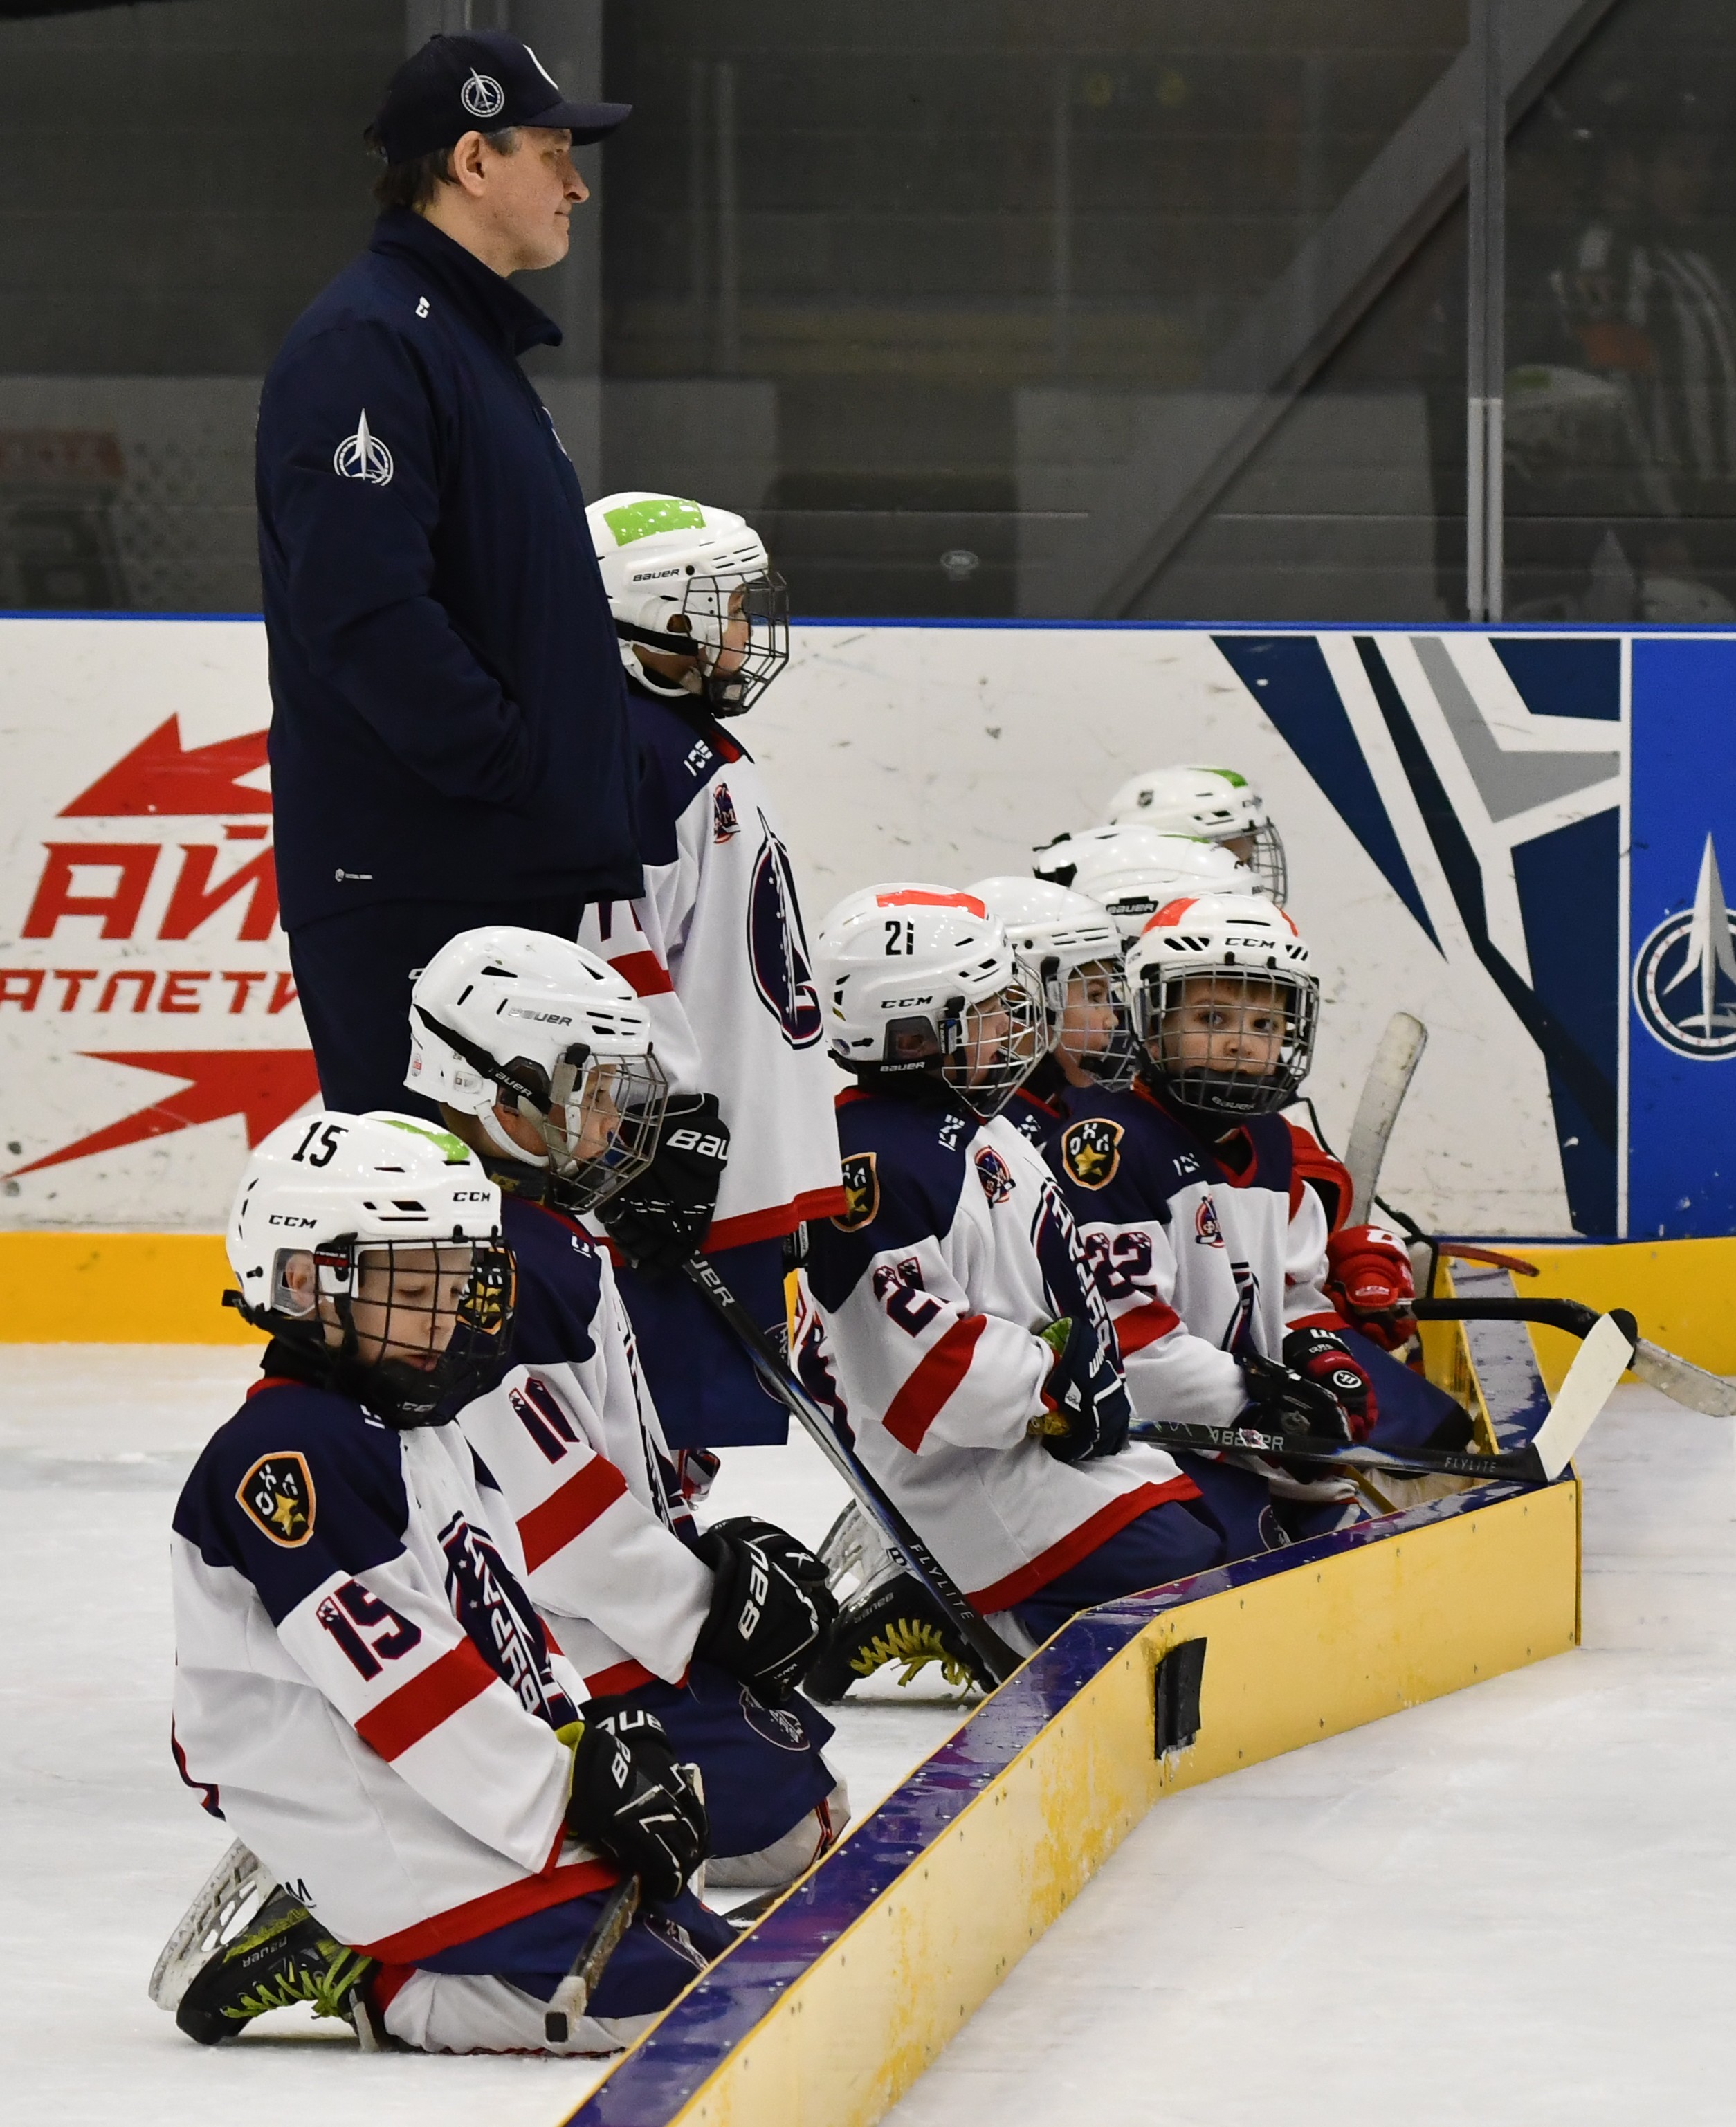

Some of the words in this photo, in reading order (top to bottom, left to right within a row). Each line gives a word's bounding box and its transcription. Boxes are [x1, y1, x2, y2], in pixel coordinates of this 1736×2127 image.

[632, 569, 680, 583] BAUER
[1107, 902, 1155, 915] BAUER
[884, 920, 914, 956] 21
[1224, 937, 1276, 949] CCM
[880, 995, 933, 1009] CCM
[879, 1061, 925, 1072] BAUER
[488, 1068, 533, 1097] AUER
[291, 1121, 349, 1167] 15
[453, 1191, 491, 1203] CCM
[268, 1214, 318, 1229] CCM
[1084, 1231, 1157, 1302] 22
[1444, 1457, 1497, 1473] FLYLITE
[909, 1543, 974, 1621] FLYLITE
[316, 1578, 423, 1683] 15
